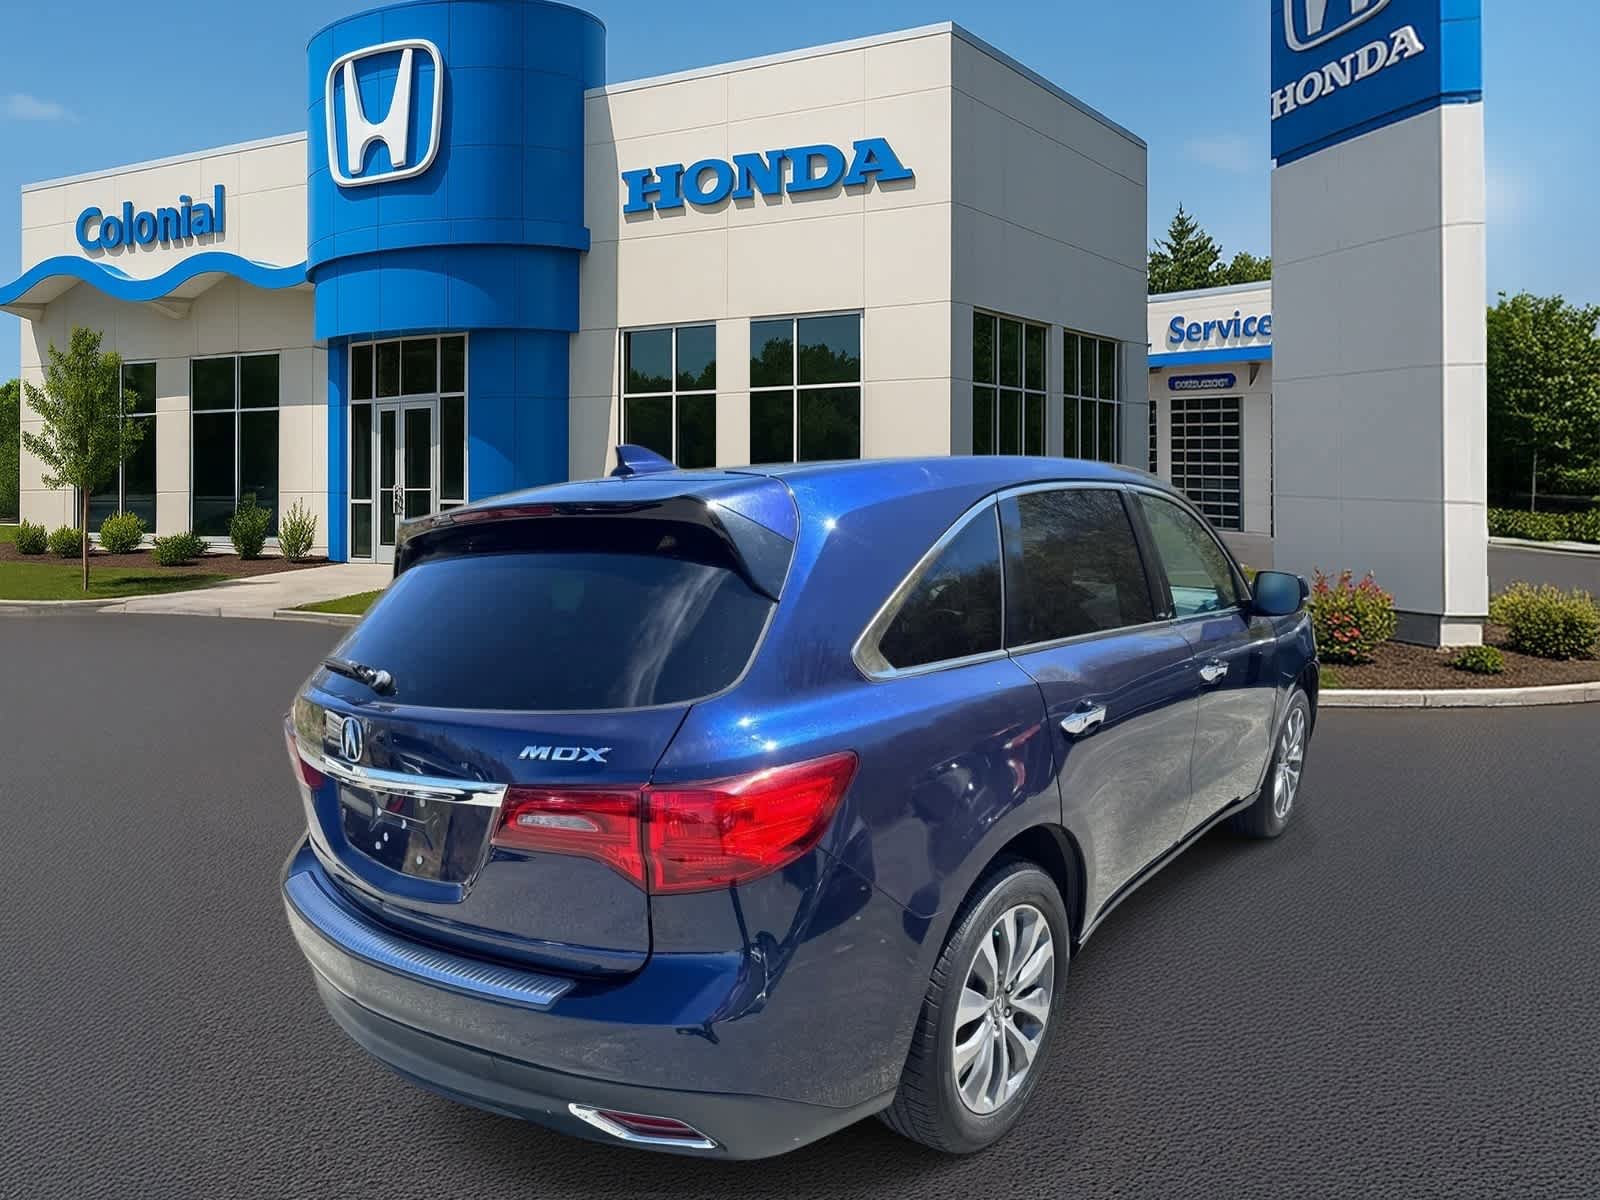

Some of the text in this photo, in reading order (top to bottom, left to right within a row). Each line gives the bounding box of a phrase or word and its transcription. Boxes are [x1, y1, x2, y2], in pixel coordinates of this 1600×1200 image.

[1271, 25, 1424, 120] HONDA
[621, 137, 913, 214] HONDA
[76, 185, 225, 252] Colonial
[1169, 310, 1272, 345] Service
[519, 745, 611, 763] MDX
